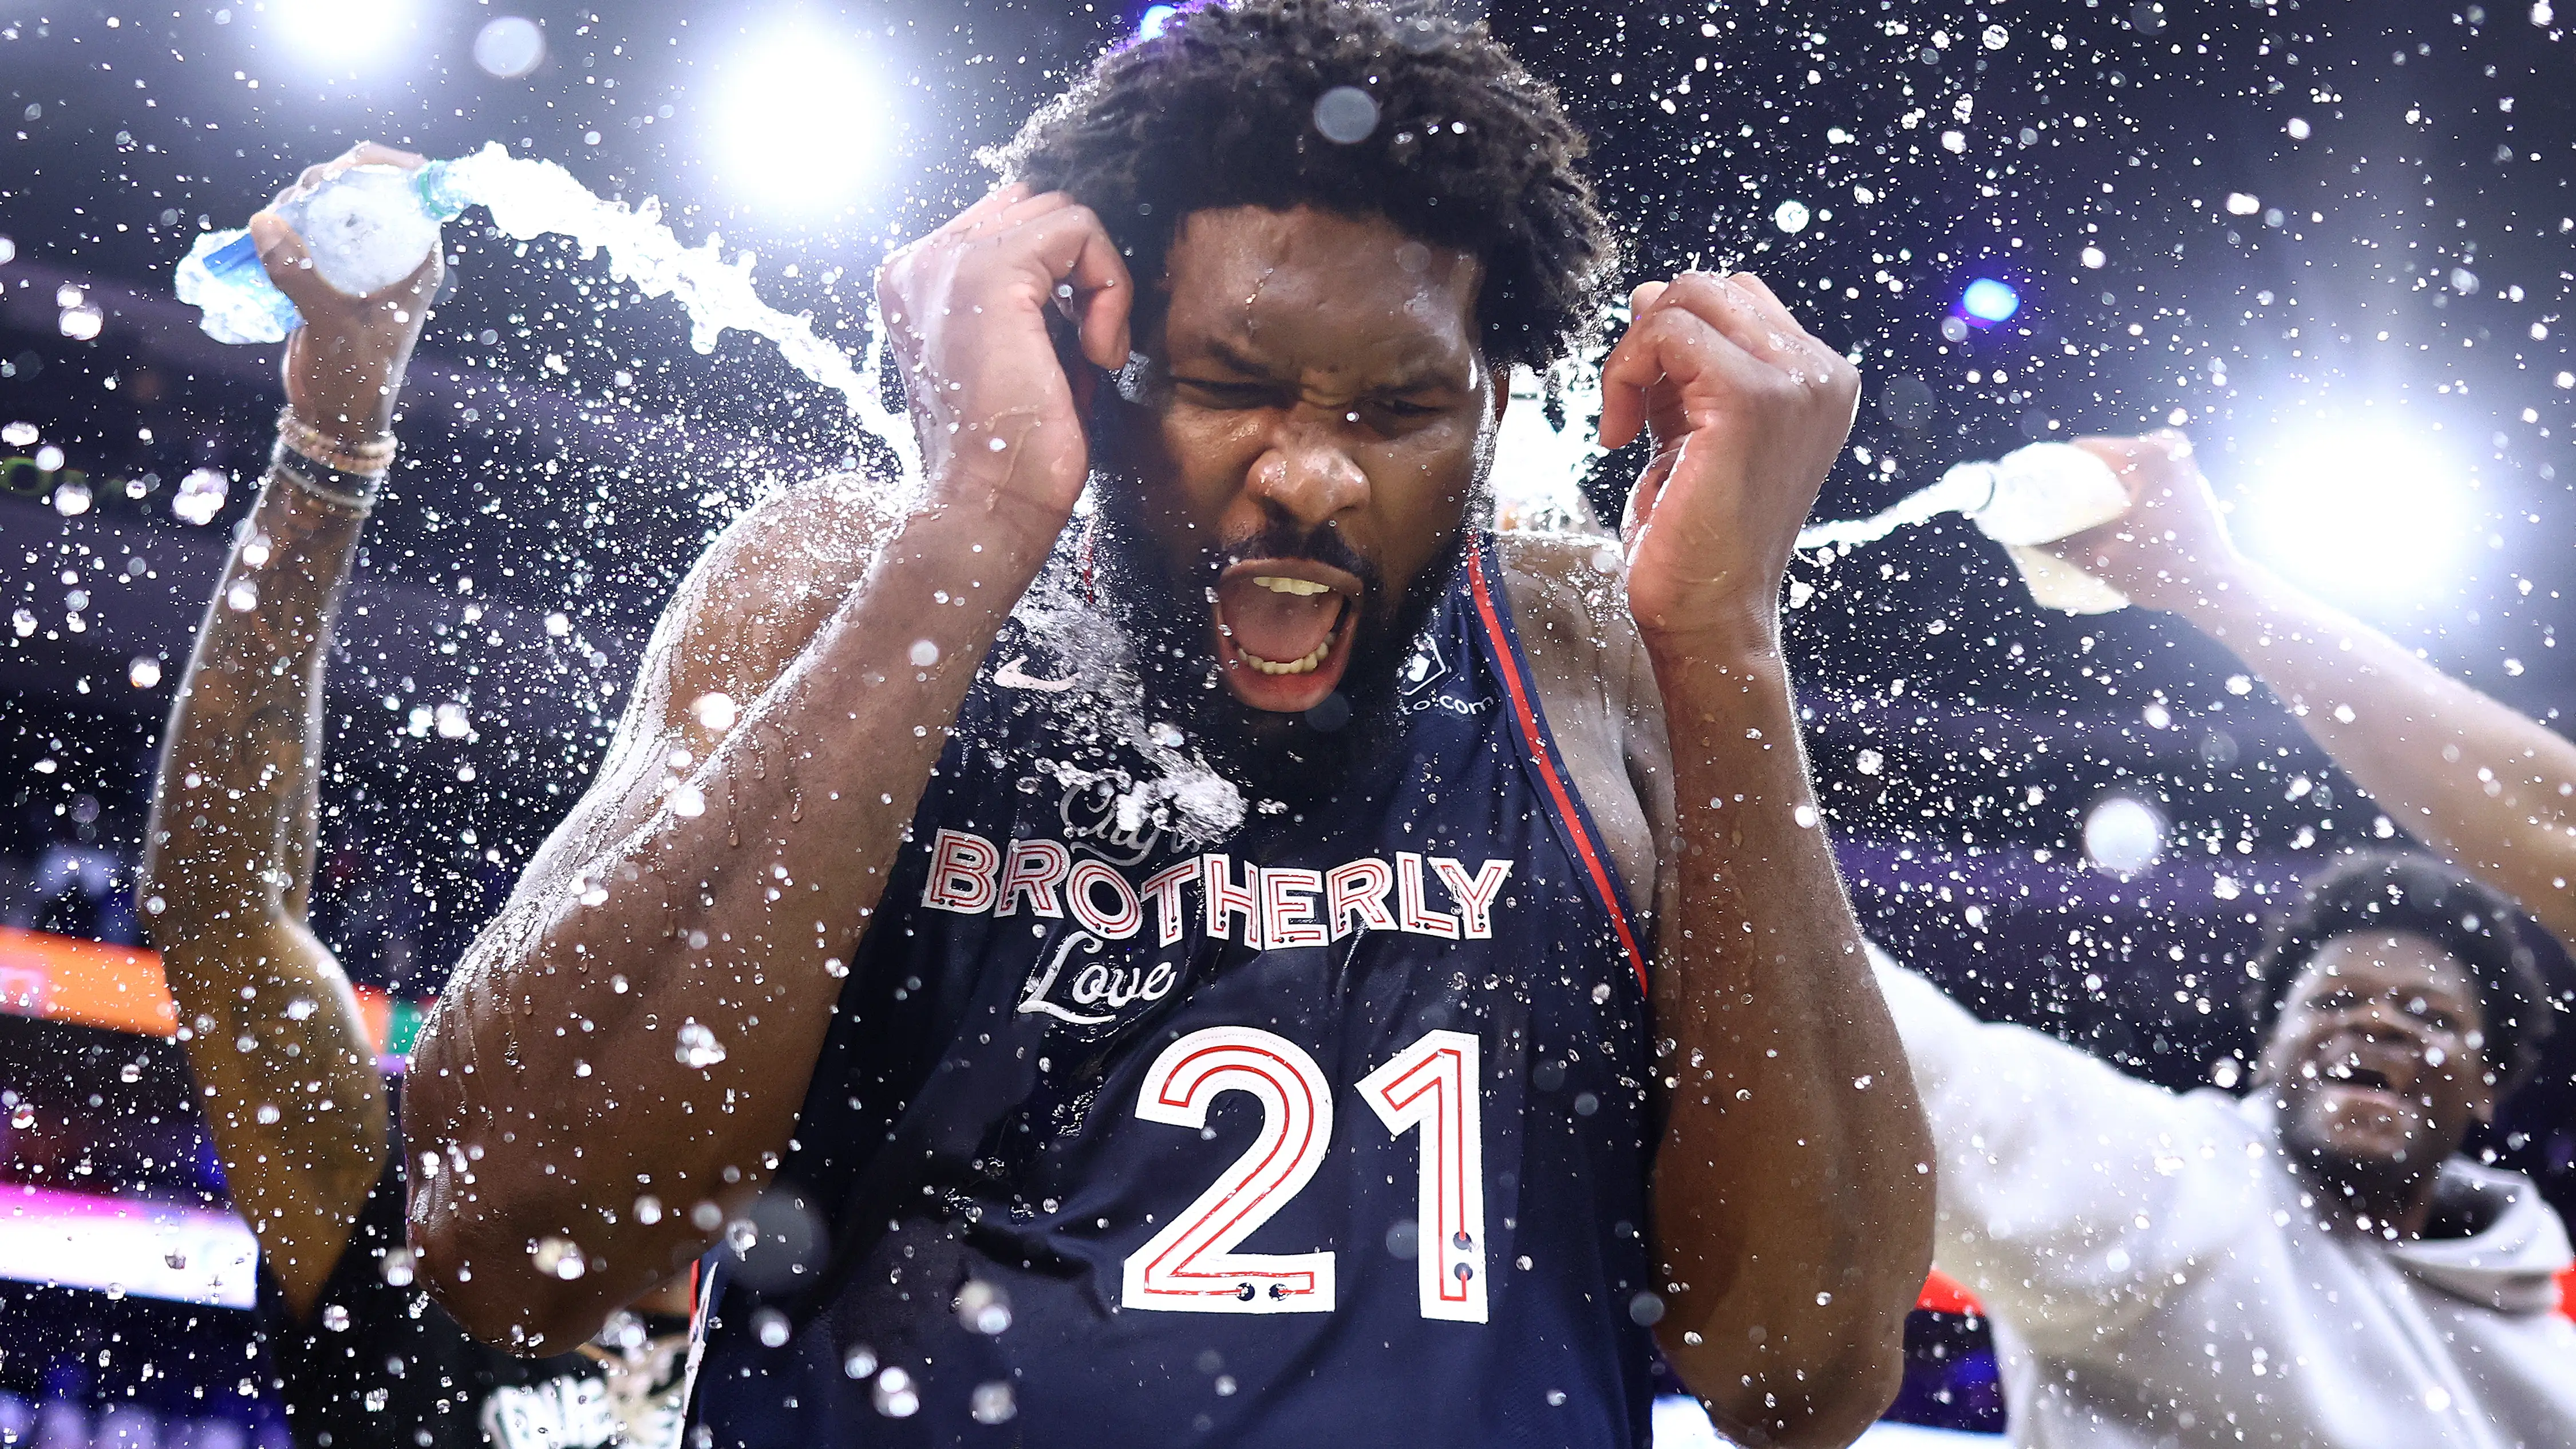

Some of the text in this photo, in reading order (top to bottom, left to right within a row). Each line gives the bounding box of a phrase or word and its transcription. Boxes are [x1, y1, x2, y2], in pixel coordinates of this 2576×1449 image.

[922, 828, 1513, 950] BROTHERLY
[1018, 930, 1177, 1024] Love
[1122, 1026, 1489, 1324] 21
